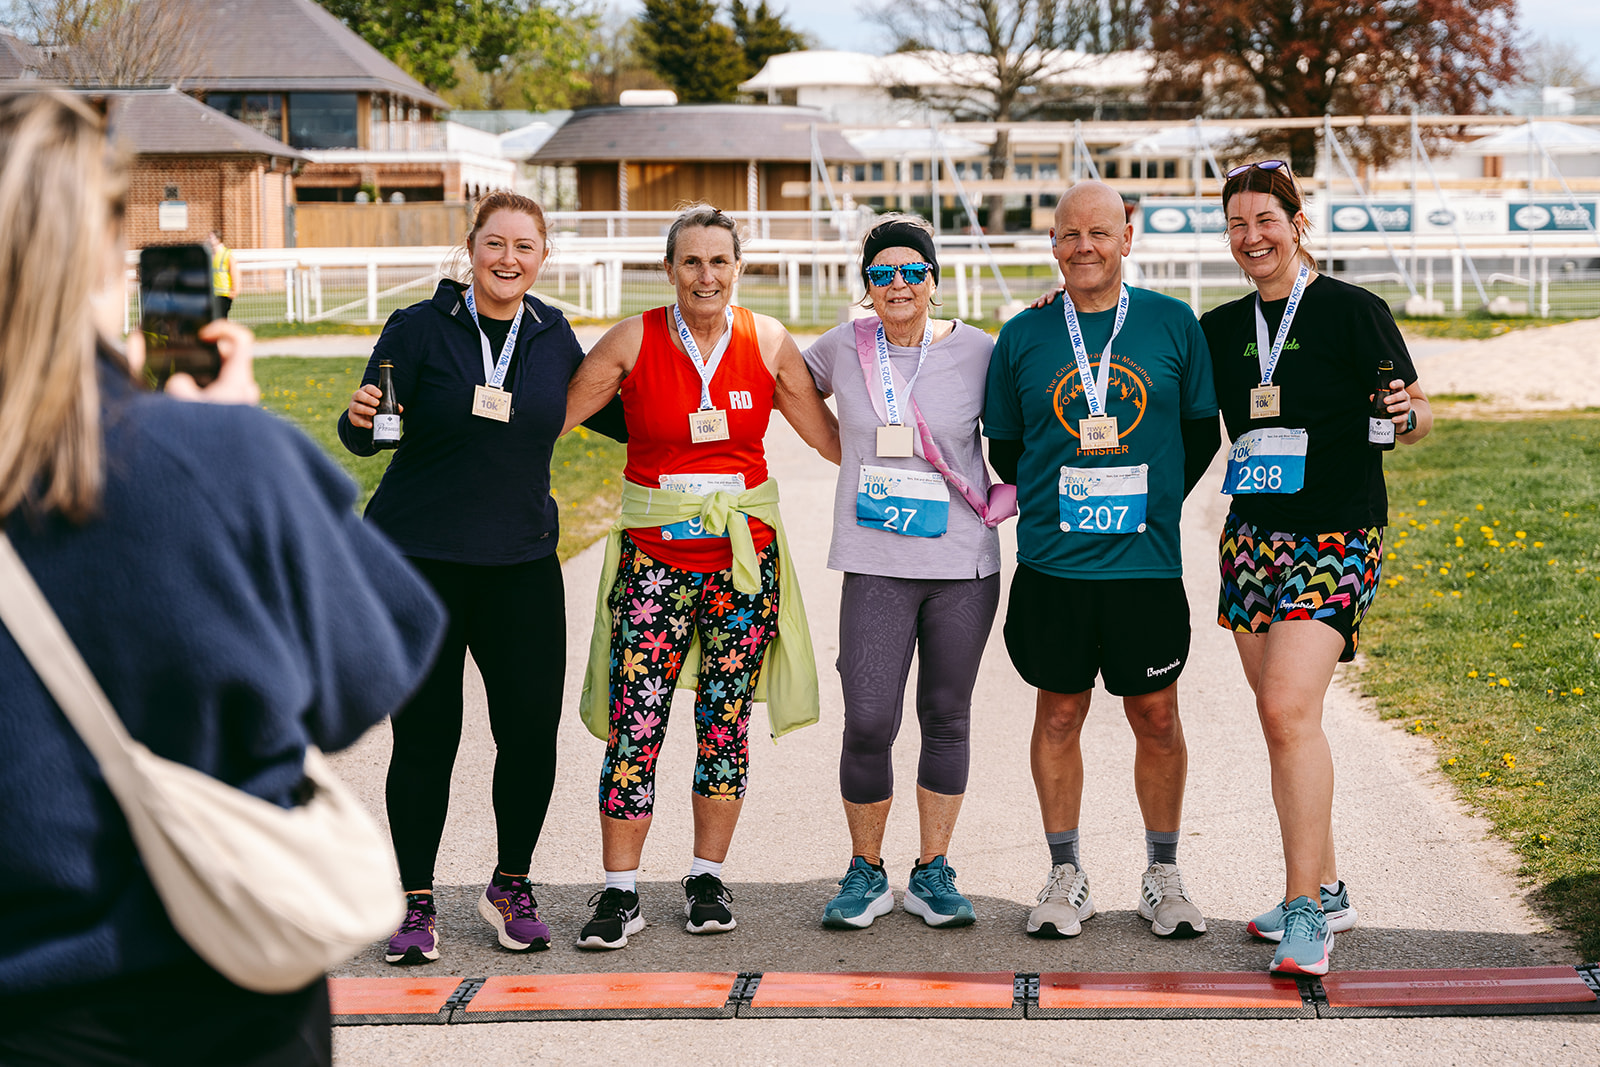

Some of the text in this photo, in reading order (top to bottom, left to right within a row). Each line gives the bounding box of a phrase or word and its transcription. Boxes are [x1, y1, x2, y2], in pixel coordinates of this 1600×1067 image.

[878, 342, 889, 364] TEWV
[881, 366, 892, 386] 2025
[1121, 355, 1154, 387] Marathon
[729, 390, 753, 410] RD
[885, 388, 895, 403] 10k
[481, 400, 498, 411] 10k
[1089, 397, 1099, 413] 10k
[1255, 400, 1269, 409] 10k
[696, 424, 715, 434] 10k
[1087, 431, 1106, 441] 10k
[1233, 446, 1251, 460] 10k
[864, 475, 887, 484] TEWV
[1236, 465, 1283, 490] 298
[864, 482, 889, 496] 10k
[1064, 484, 1089, 496] 10k
[883, 506, 917, 532] 27
[1078, 506, 1129, 530] 207
